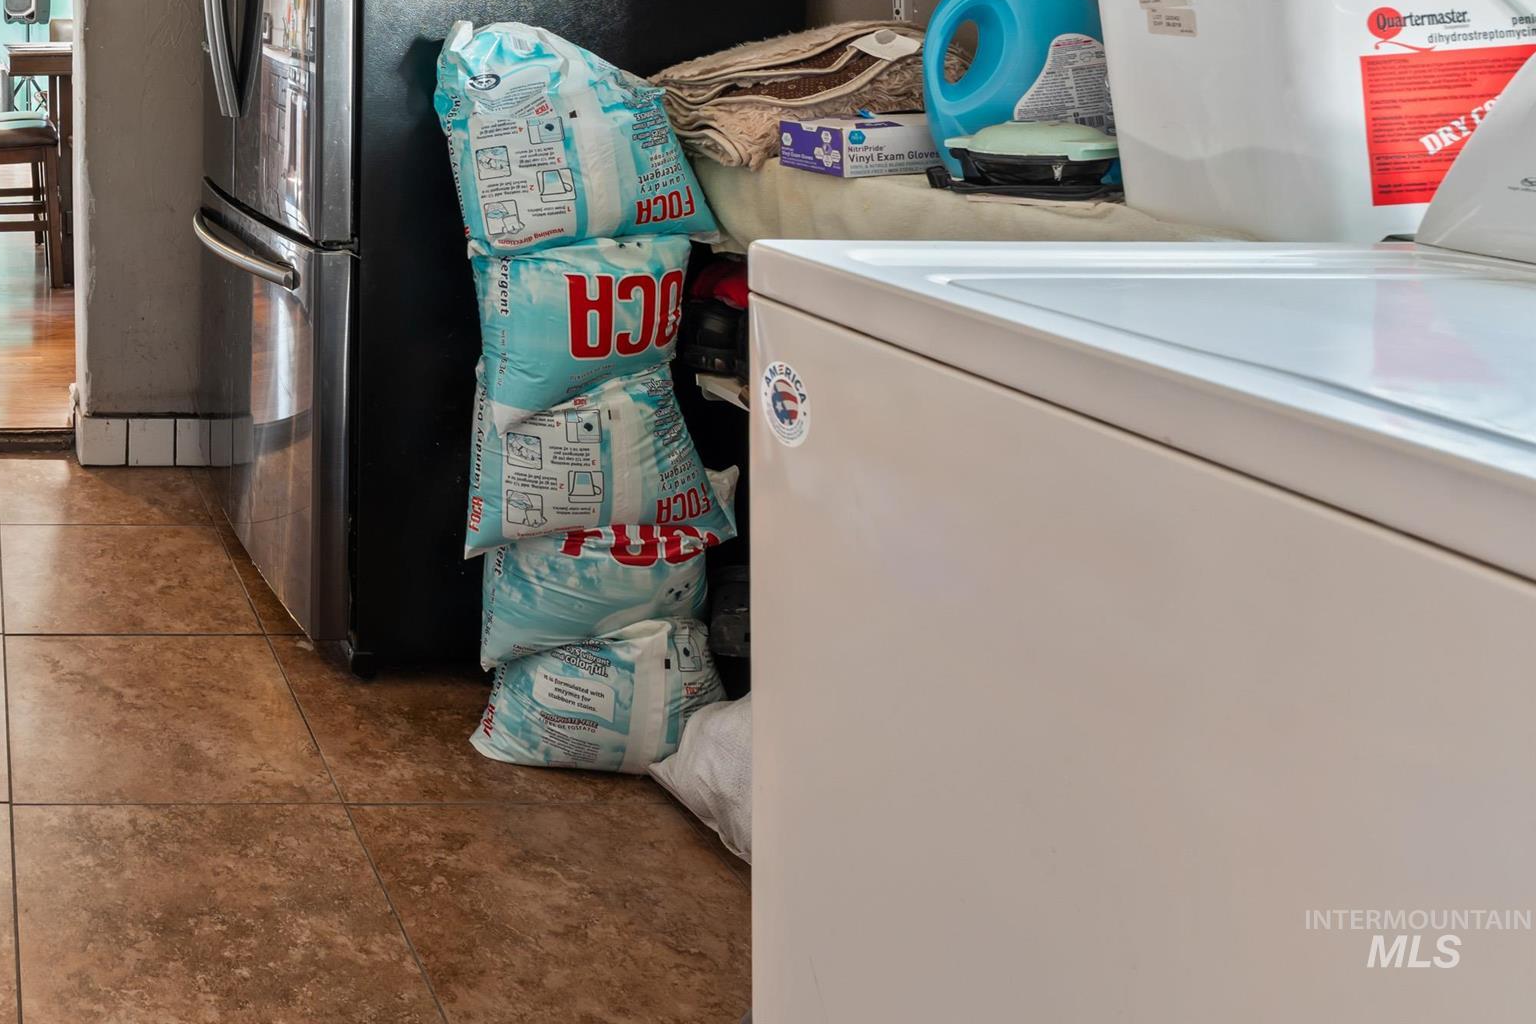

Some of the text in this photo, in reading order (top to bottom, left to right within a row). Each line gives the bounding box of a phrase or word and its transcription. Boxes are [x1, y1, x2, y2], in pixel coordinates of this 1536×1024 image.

[1419, 115, 1472, 156] DRY
[848, 145, 884, 153] NitriPride
[848, 149, 940, 163] Vinyl Exam Gloves
[638, 164, 682, 186] Detergent
[529, 184, 534, 192] 2
[635, 185, 696, 226] FOCA
[533, 226, 565, 241] Washing
[498, 256, 512, 316] tergent
[563, 270, 684, 360] OCA
[764, 363, 807, 404] AMERICA
[472, 425, 485, 492] Laundry
[468, 495, 484, 533] FOCA
[655, 481, 711, 524] FOCA
[565, 654, 609, 678] colorful.
[584, 651, 610, 666] vibrant
[554, 678, 589, 694] formulated
[590, 690, 605, 698] with
[554, 687, 592, 703] enzymes for
[548, 692, 598, 713] stubborn stains.
[482, 704, 496, 738] FOCA
